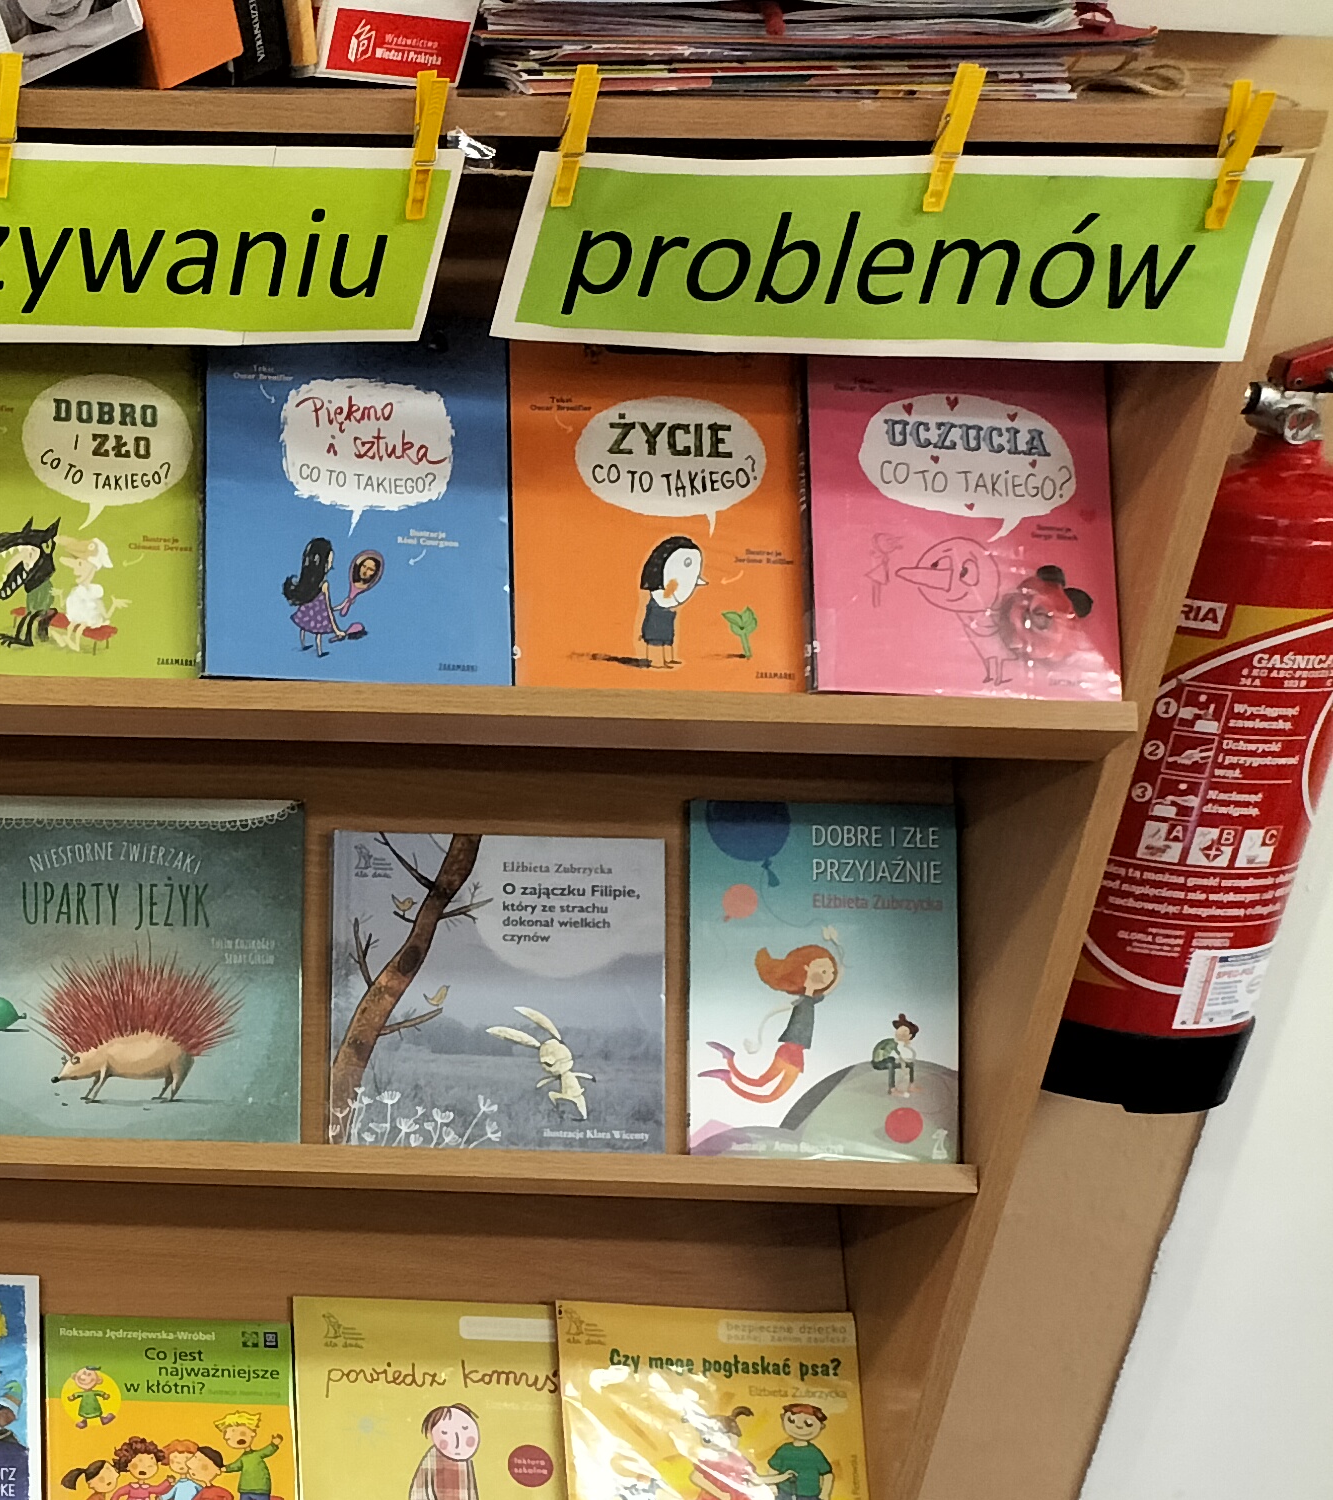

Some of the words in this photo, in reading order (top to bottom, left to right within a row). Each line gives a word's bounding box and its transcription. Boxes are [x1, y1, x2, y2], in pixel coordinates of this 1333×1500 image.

[564, 209, 1201, 316] problemów
[52, 398, 158, 429] DOBRO
[91, 433, 151, 460] ZŁO
[353, 431, 450, 463] sztuka
[608, 413, 733, 459] ŻYCIE
[883, 417, 1051, 458] UCZUCIA
[354, 473, 436, 494] TAKIEGO?
[812, 824, 881, 848] DOBRE
[900, 826, 940, 850] ZŁE
[502, 860, 550, 876] Elżbieta
[553, 862, 613, 877] Zubrzycka
[812, 858, 942, 885] PRZYJAŹNIE
[521, 884, 586, 899] zajączku
[22, 881, 119, 926] UPARTY
[560, 903, 609, 915] strachu
[502, 915, 555, 930] dokonał
[558, 916, 611, 930] wielkich
[502, 931, 551, 945] czynów
[171, 1346, 204, 1366] jest
[158, 1362, 280, 1383] najważniejsze
[142, 1377, 206, 1398] kłótni?
